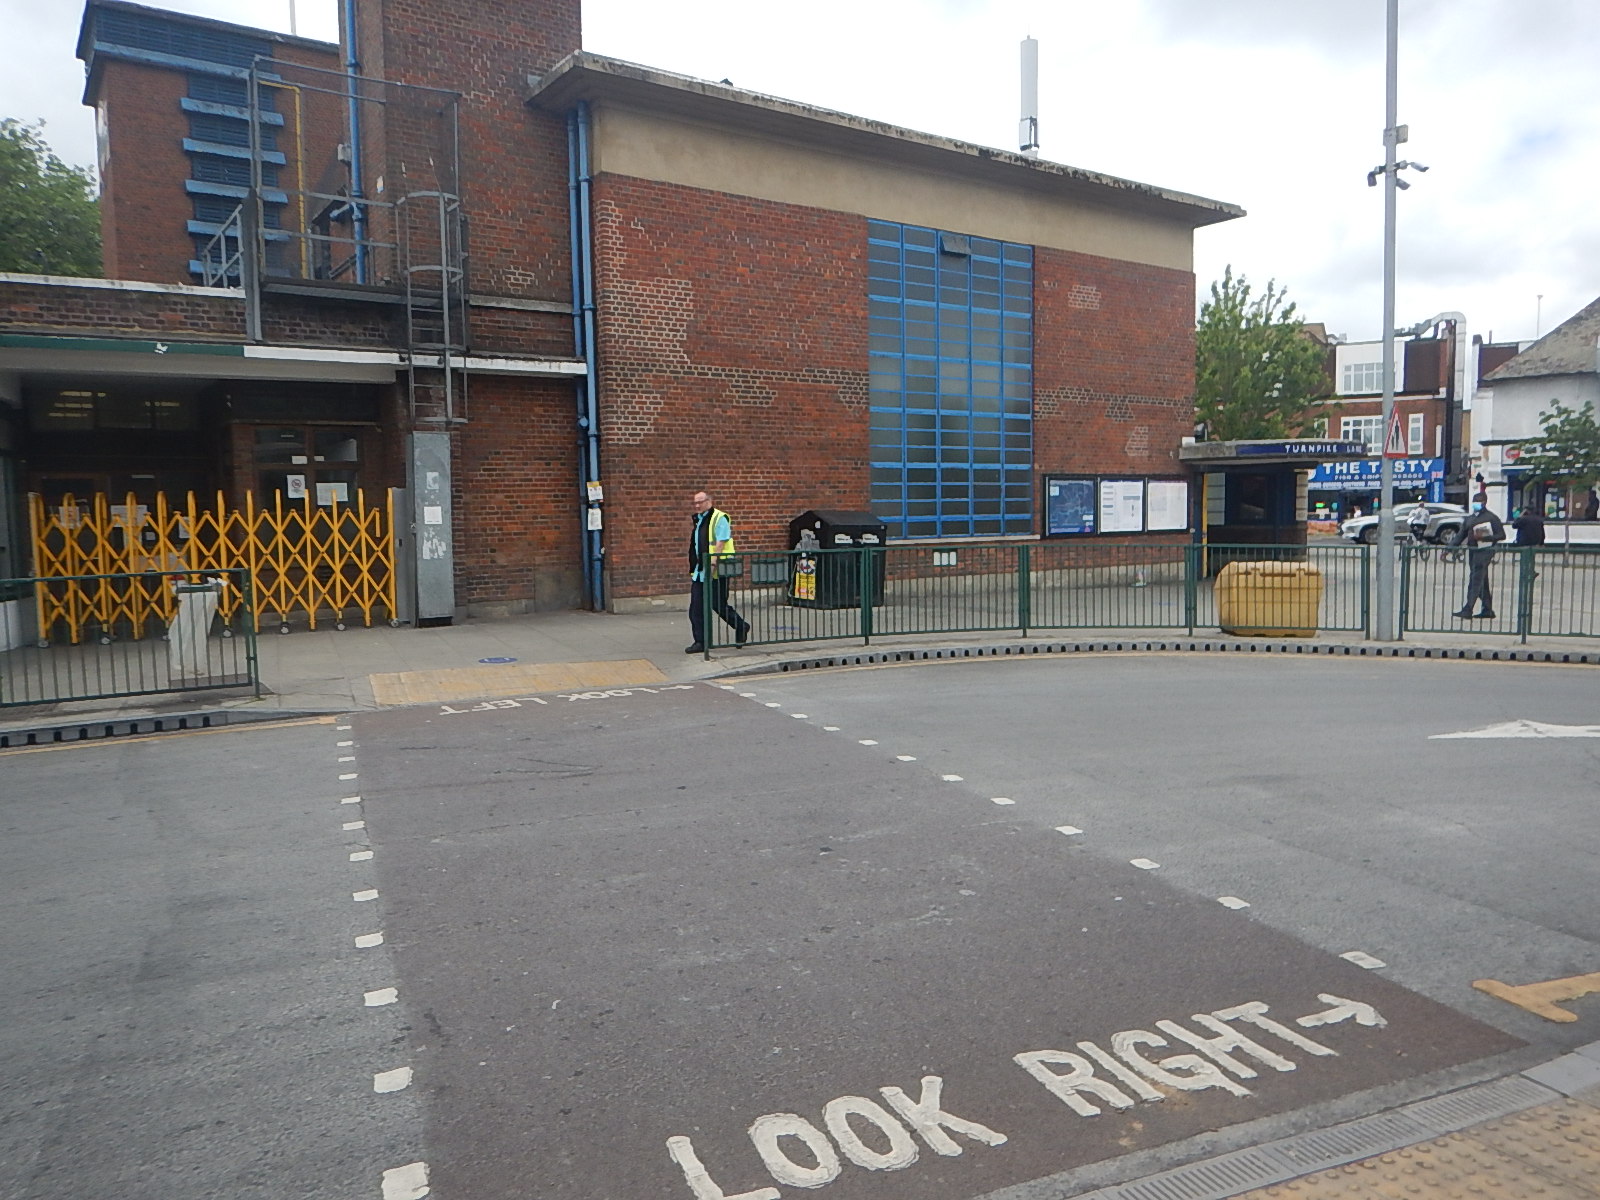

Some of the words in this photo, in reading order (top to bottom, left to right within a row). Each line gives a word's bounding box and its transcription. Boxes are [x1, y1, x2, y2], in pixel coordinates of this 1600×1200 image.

[1285, 444, 1337, 453] TURNPIKE
[1323, 462, 1360, 474] THE
[1368, 460, 1433, 473] TSTY
[556, 687, 659, 702] LOOK
[439, 697, 548, 716] LEFT
[665, 1075, 1008, 1200] LOOK
[1012, 1001, 1339, 1117] RIGHT
